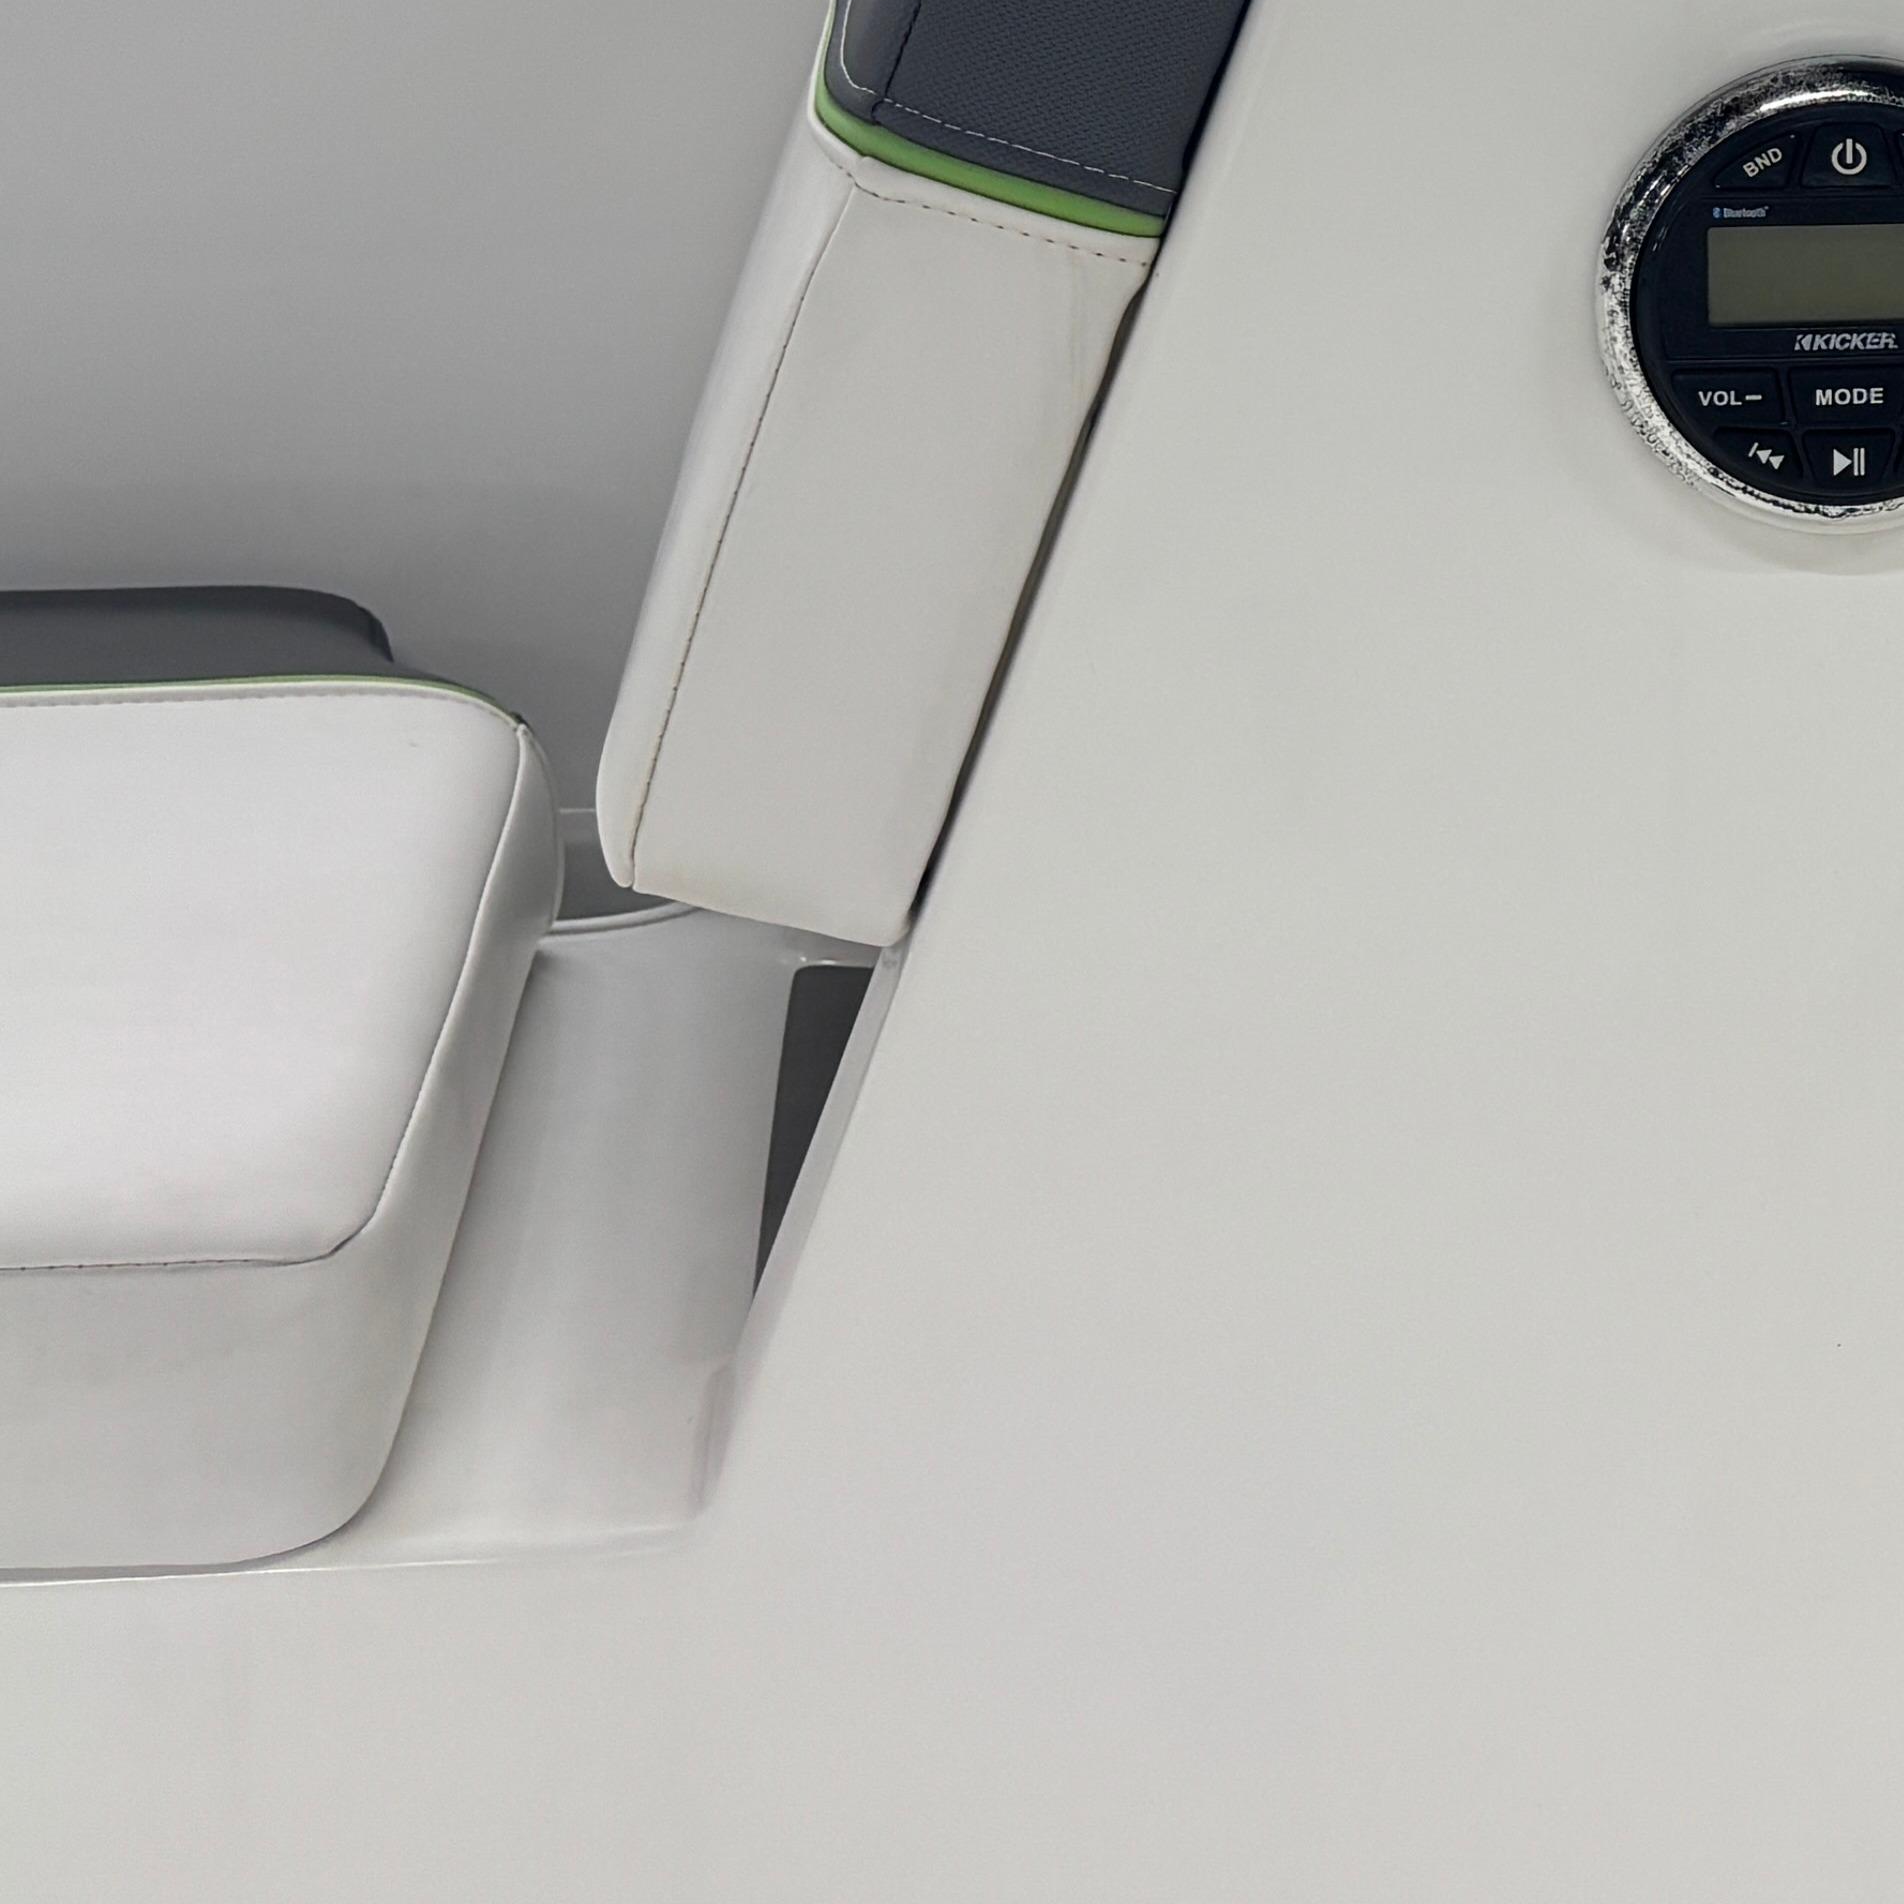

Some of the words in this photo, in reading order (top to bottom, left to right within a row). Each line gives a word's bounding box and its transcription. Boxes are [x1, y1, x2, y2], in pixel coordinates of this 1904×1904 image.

[1742, 147, 1784, 179] BND
[1812, 331, 1899, 352] KICKER
[1815, 386, 1884, 406] MODE
